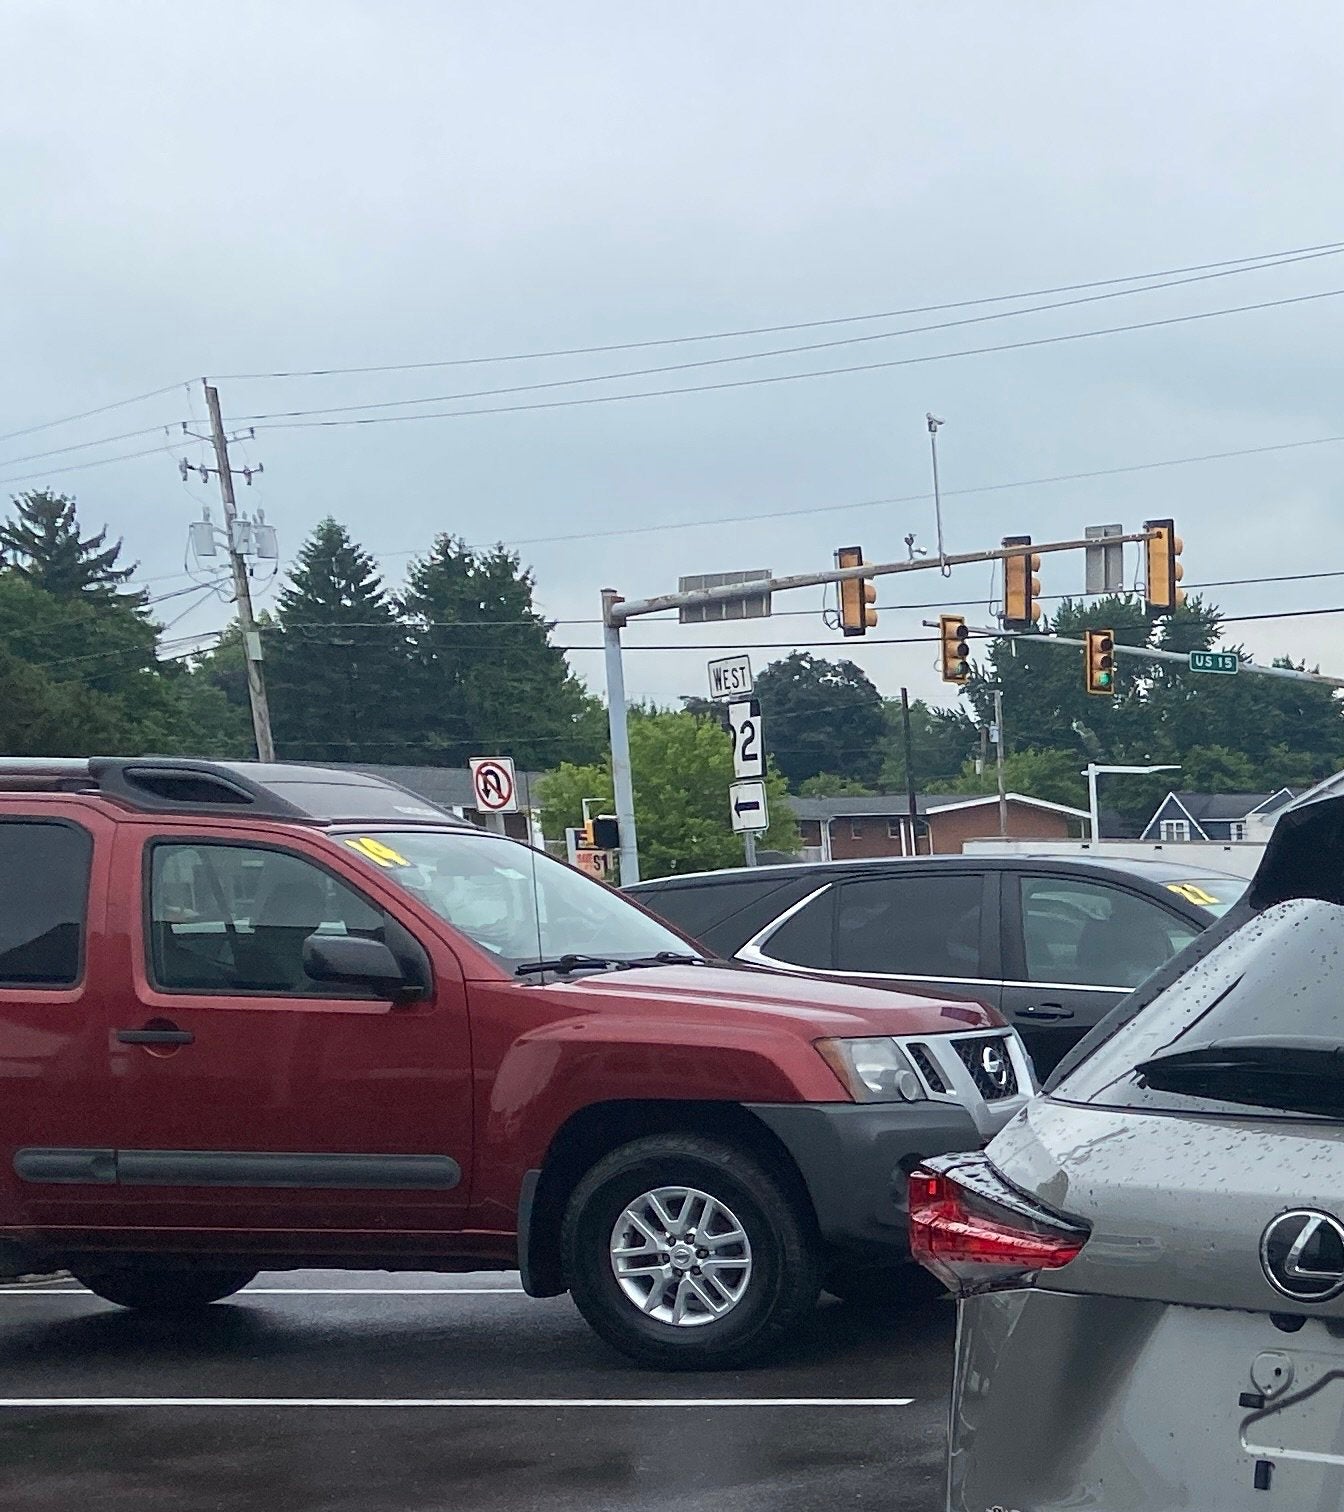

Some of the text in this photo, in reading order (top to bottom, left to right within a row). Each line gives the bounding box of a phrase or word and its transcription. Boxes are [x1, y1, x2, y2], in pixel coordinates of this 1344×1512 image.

[1195, 655, 1233, 668] US 15
[712, 666, 746, 692] WEST
